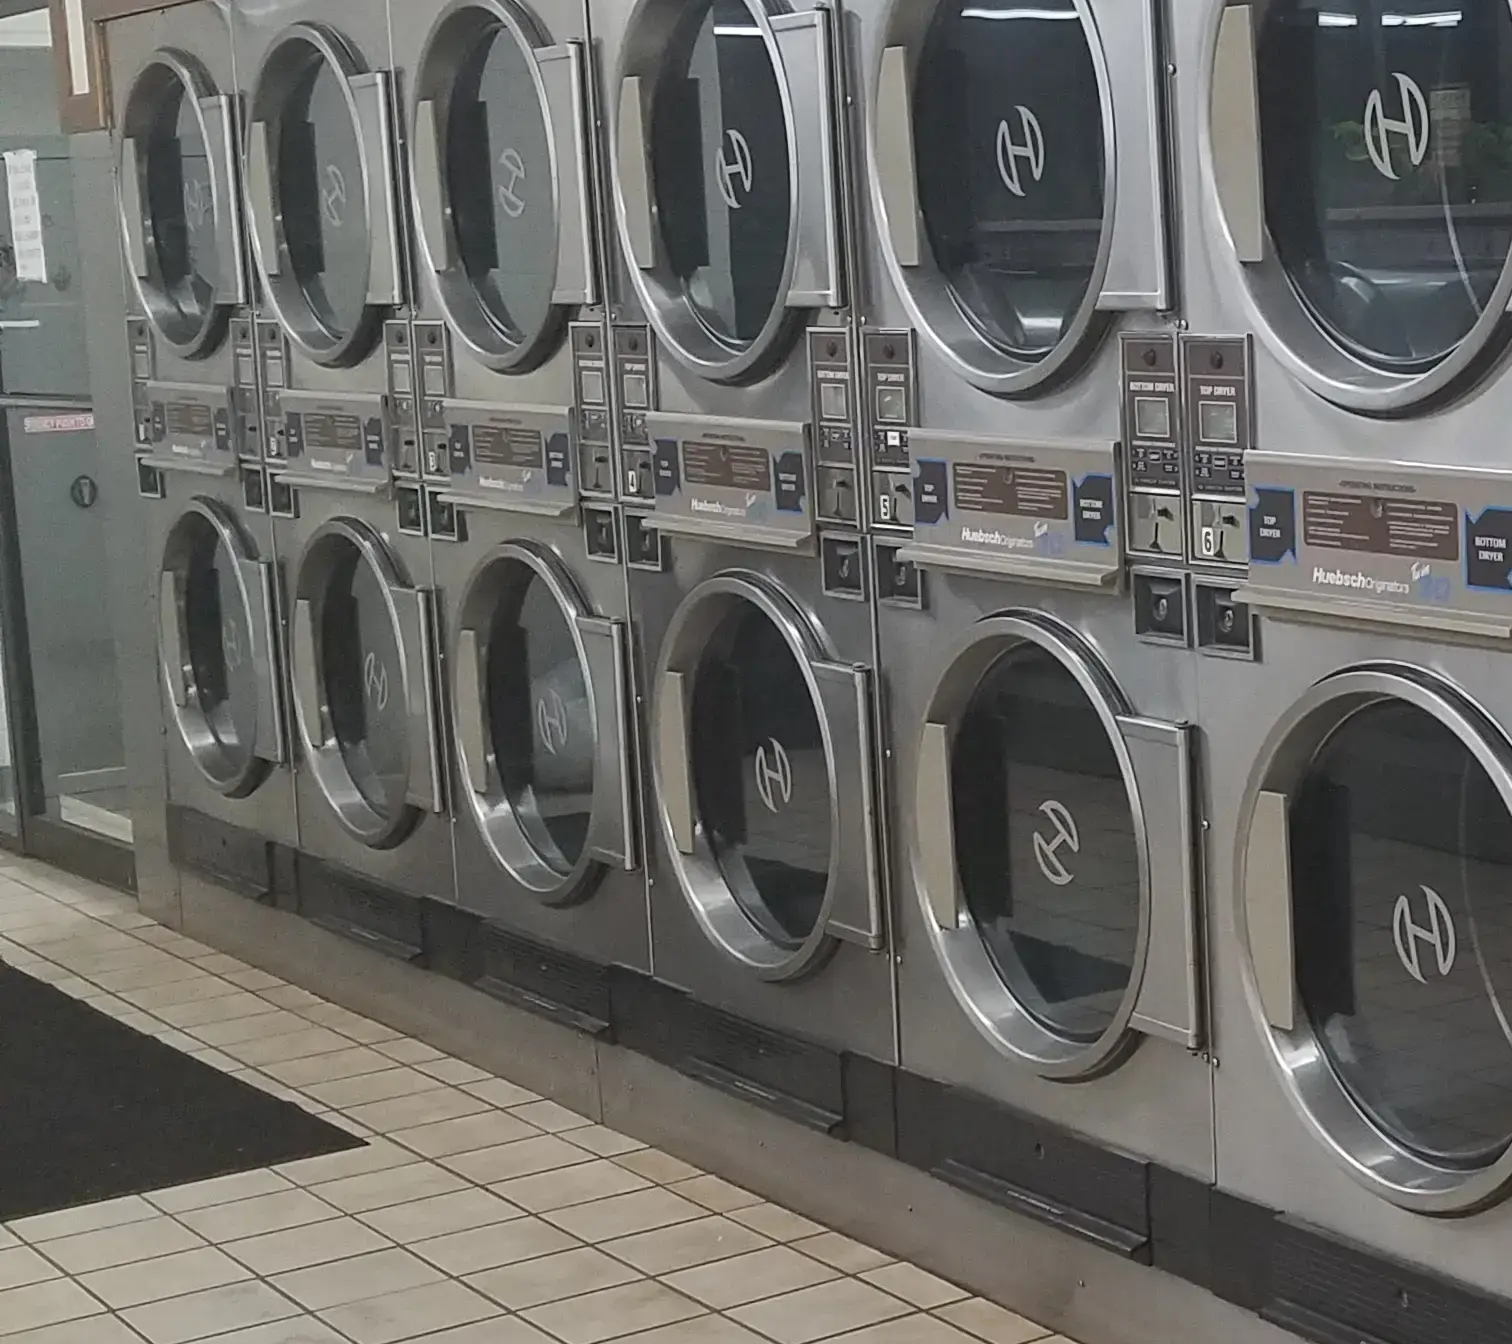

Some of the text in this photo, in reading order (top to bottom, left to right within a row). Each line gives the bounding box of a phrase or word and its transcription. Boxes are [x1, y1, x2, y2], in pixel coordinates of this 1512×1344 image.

[1200, 385, 1236, 397] TOP DRYER
[881, 497, 889, 518] 5
[1263, 516, 1276, 524] TOP
[1259, 528, 1281, 538] DRYER
[1203, 530, 1212, 553] 6
[1475, 537, 1507, 549] BOTTOM
[1479, 550, 1503, 562] DRYER
